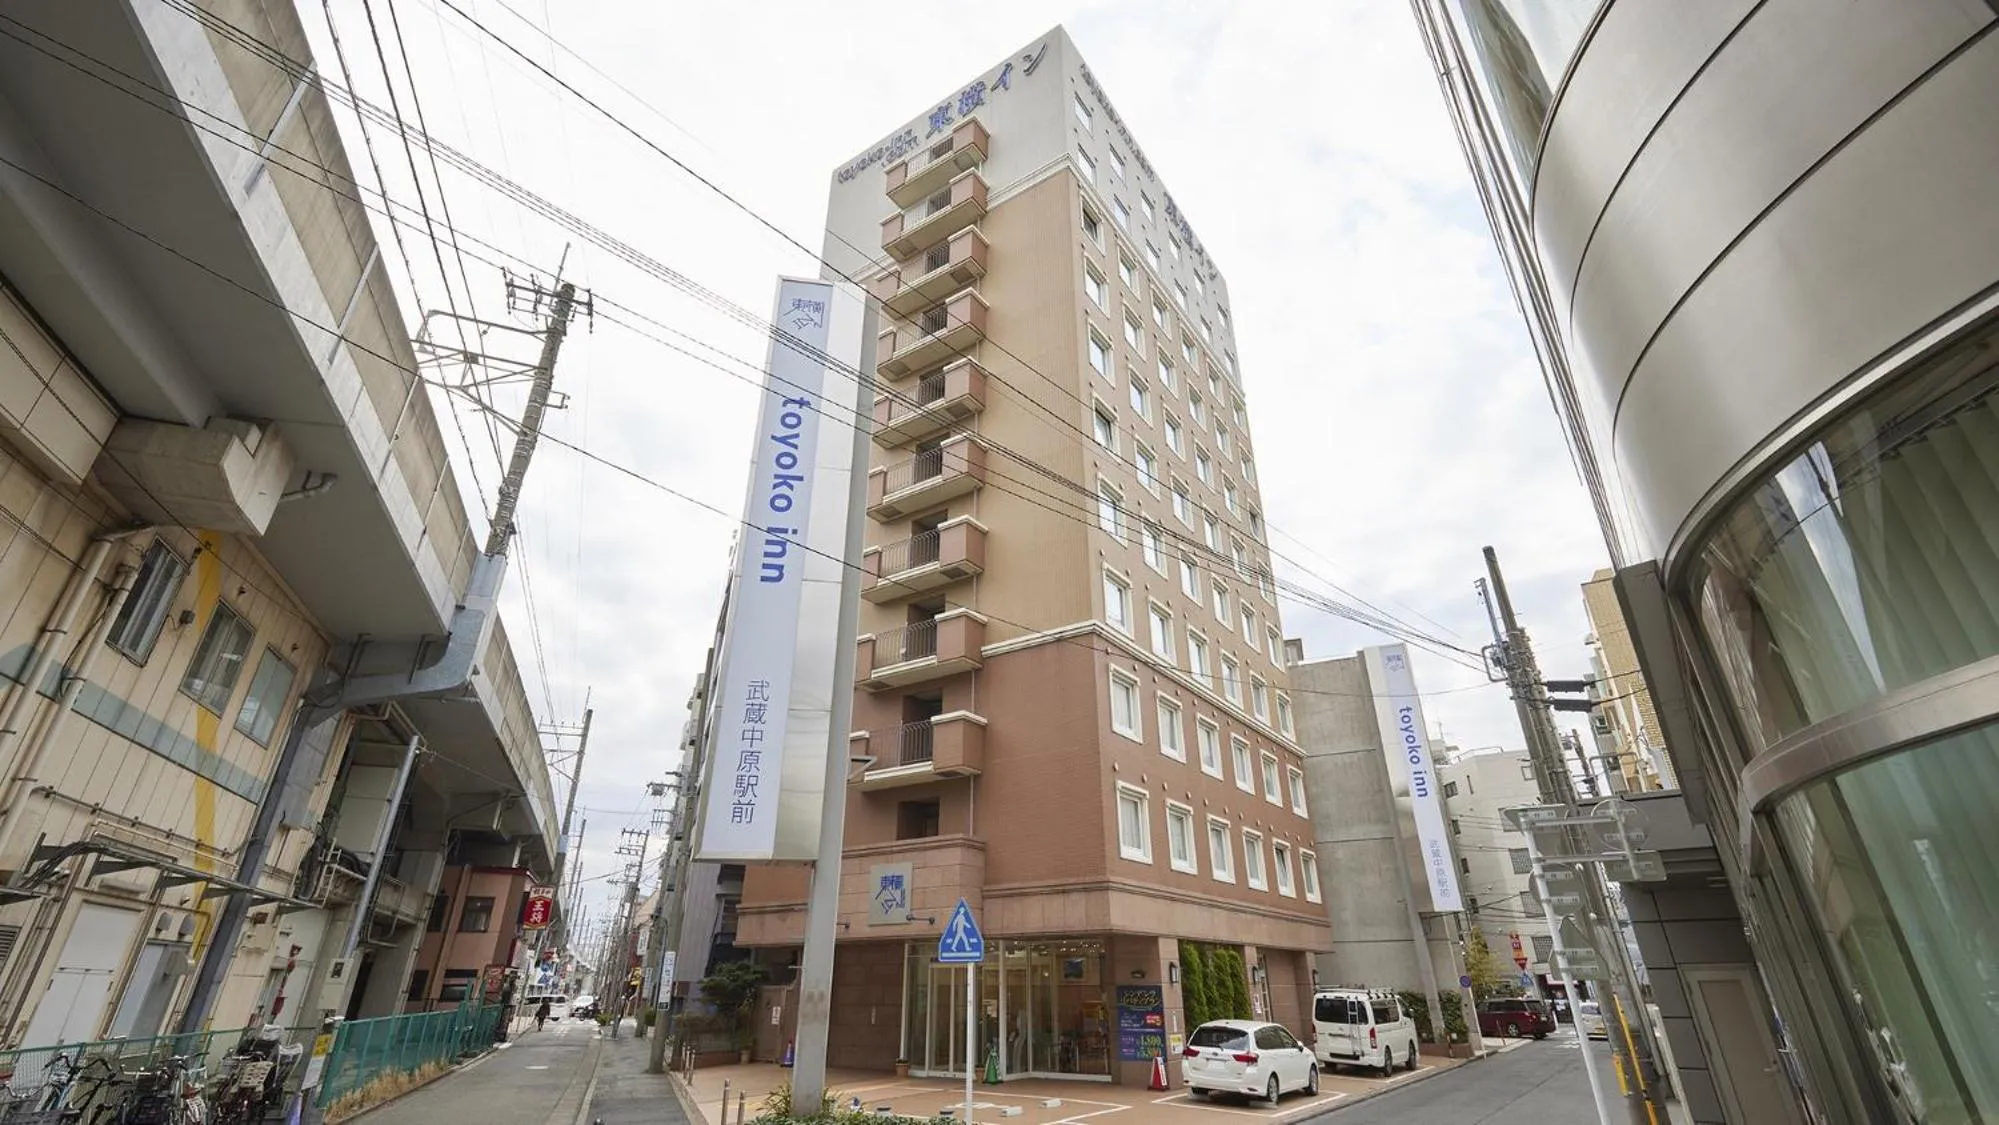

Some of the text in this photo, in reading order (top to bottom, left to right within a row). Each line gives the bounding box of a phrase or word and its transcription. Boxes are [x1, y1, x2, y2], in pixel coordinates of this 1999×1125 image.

[759, 396, 812, 583] toyoko inn
[731, 680, 770, 825] 武蔵中原駅前
[1399, 706, 1428, 798] toyoko inn
